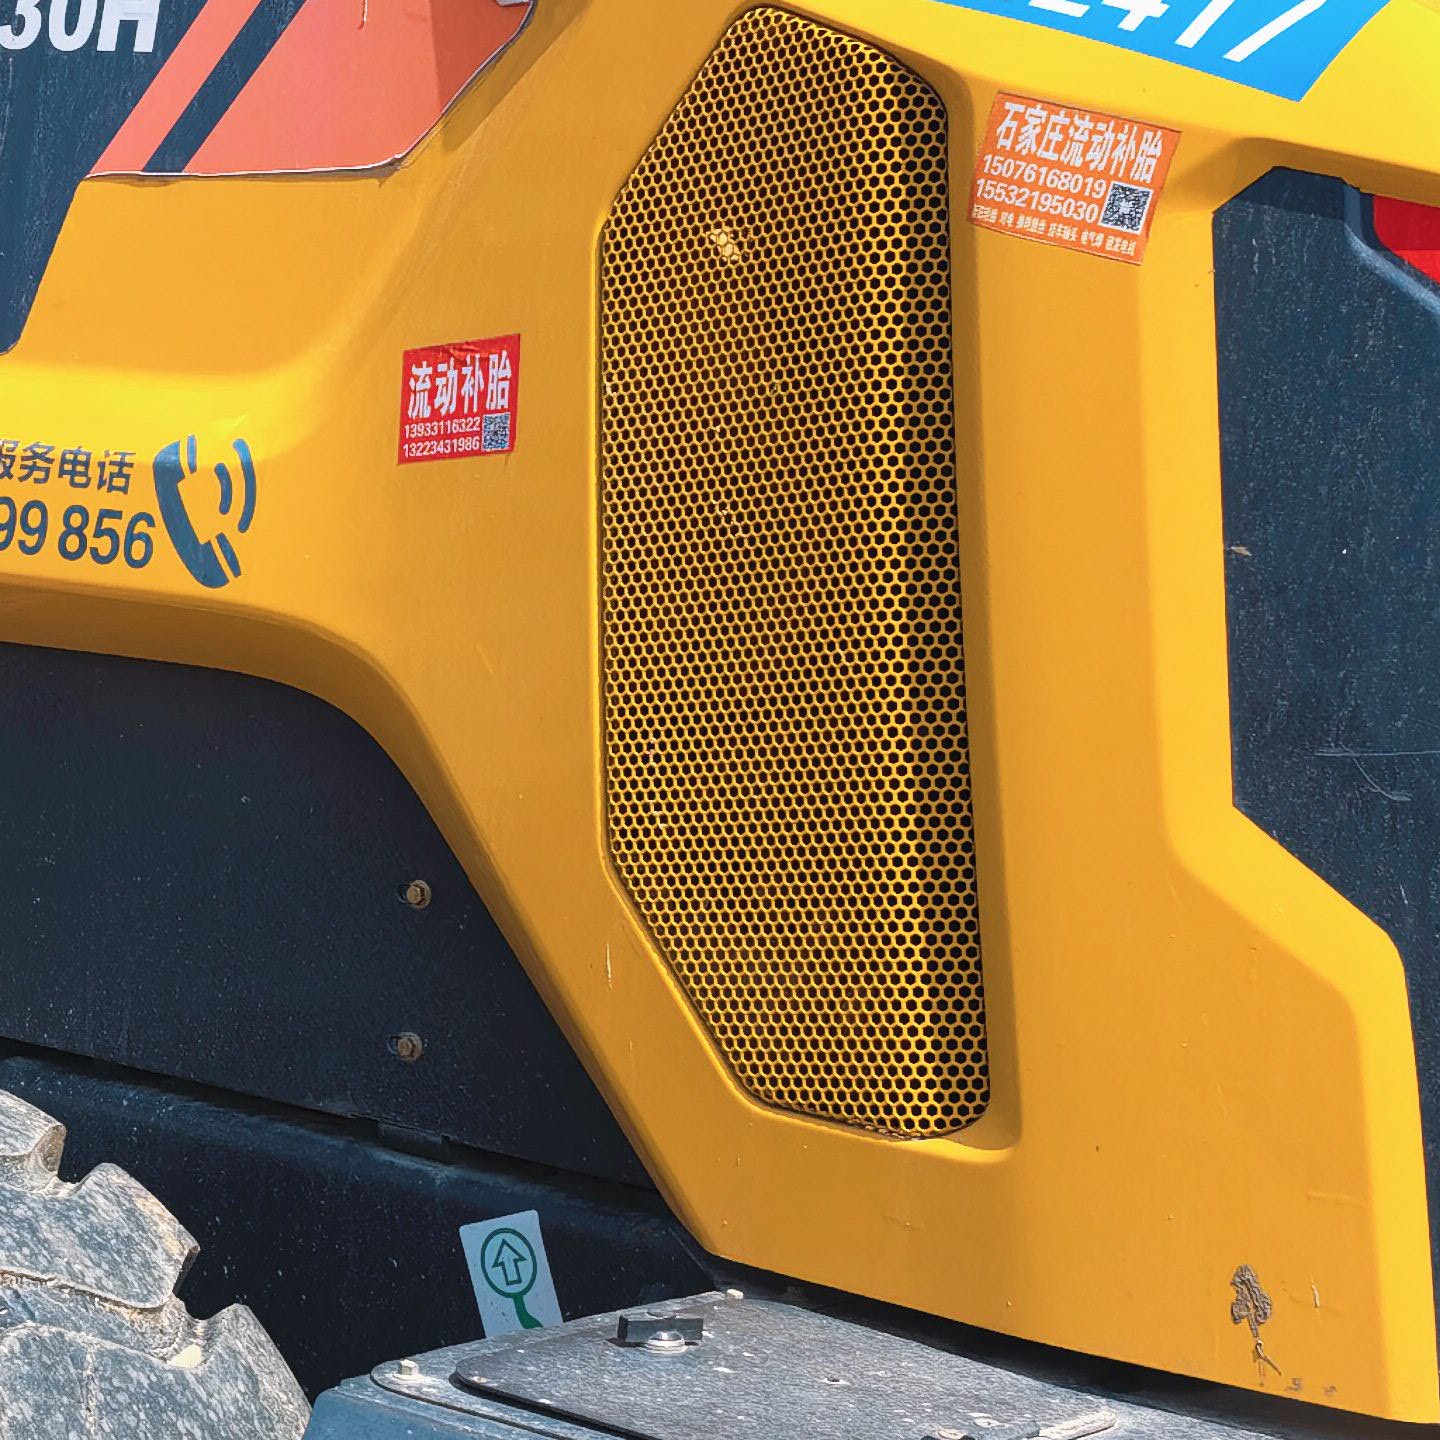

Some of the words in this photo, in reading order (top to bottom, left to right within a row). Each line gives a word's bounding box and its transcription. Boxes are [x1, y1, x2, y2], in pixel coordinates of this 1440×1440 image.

[996, 101, 1163, 184] 石家庄流动补胎
[976, 177, 1099, 224] 15532195030
[983, 153, 1107, 200] 15076168019
[407, 349, 512, 420] 流动补胎
[57, 504, 156, 569] 856
